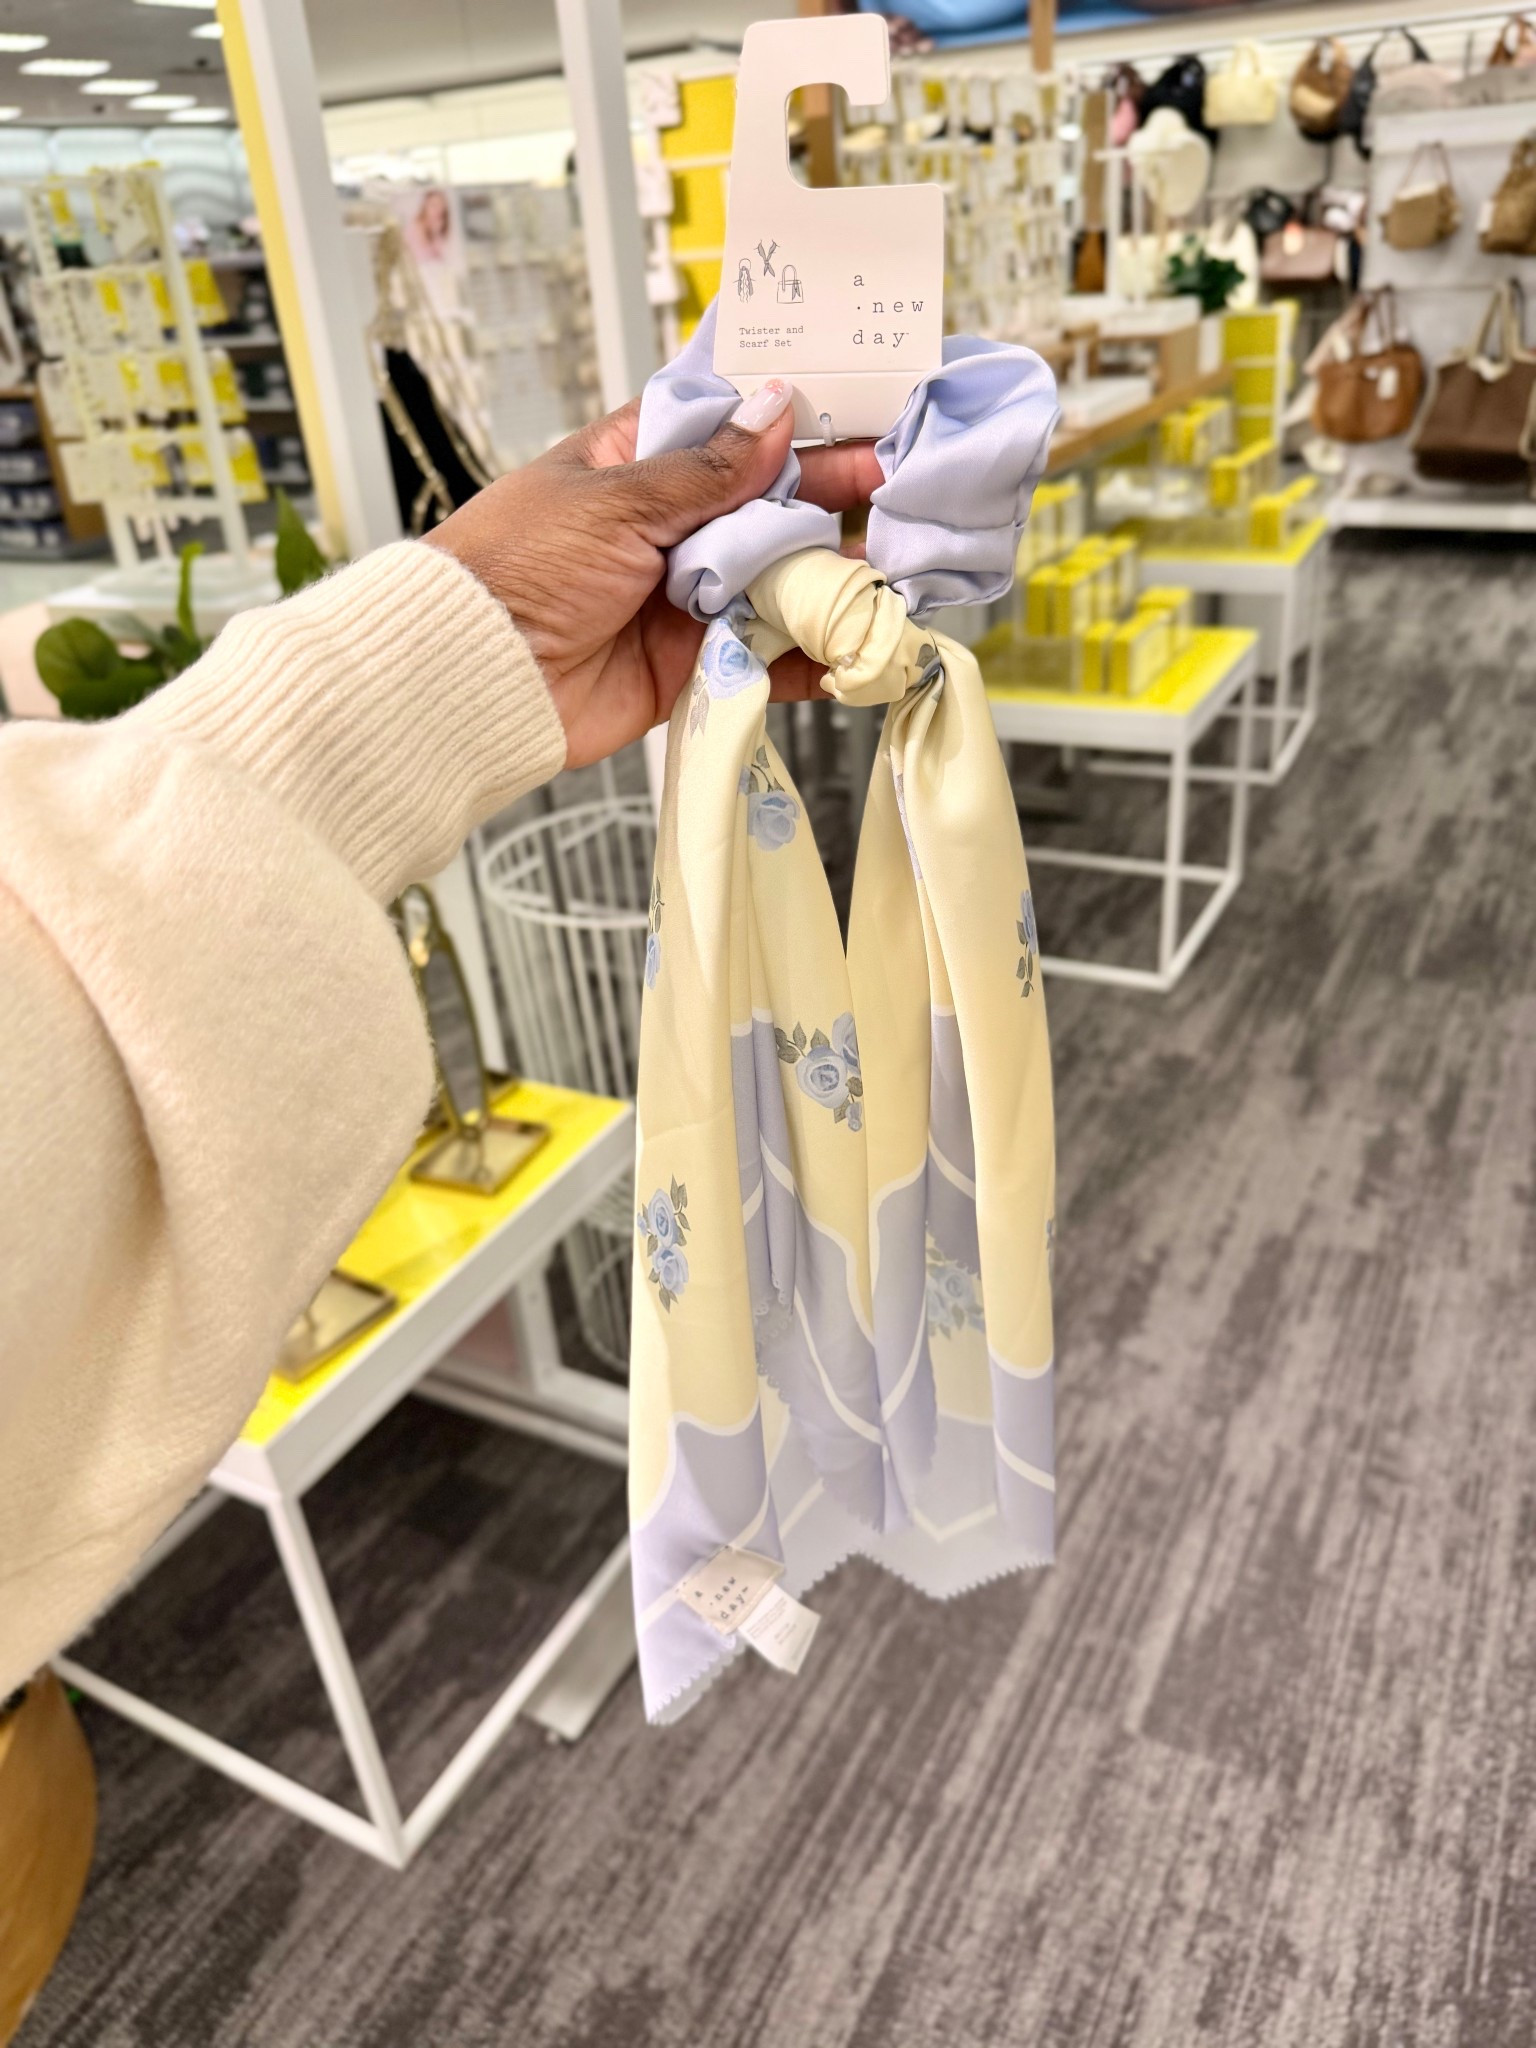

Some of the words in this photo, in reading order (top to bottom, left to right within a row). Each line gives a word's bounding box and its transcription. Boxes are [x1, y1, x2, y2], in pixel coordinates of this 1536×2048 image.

[853, 274, 865, 287] a
[738, 326, 781, 336] Twister
[786, 325, 804, 335] and
[739, 338, 769, 349] Scarf
[774, 338, 793, 348] Set
[852, 329, 905, 349] day
